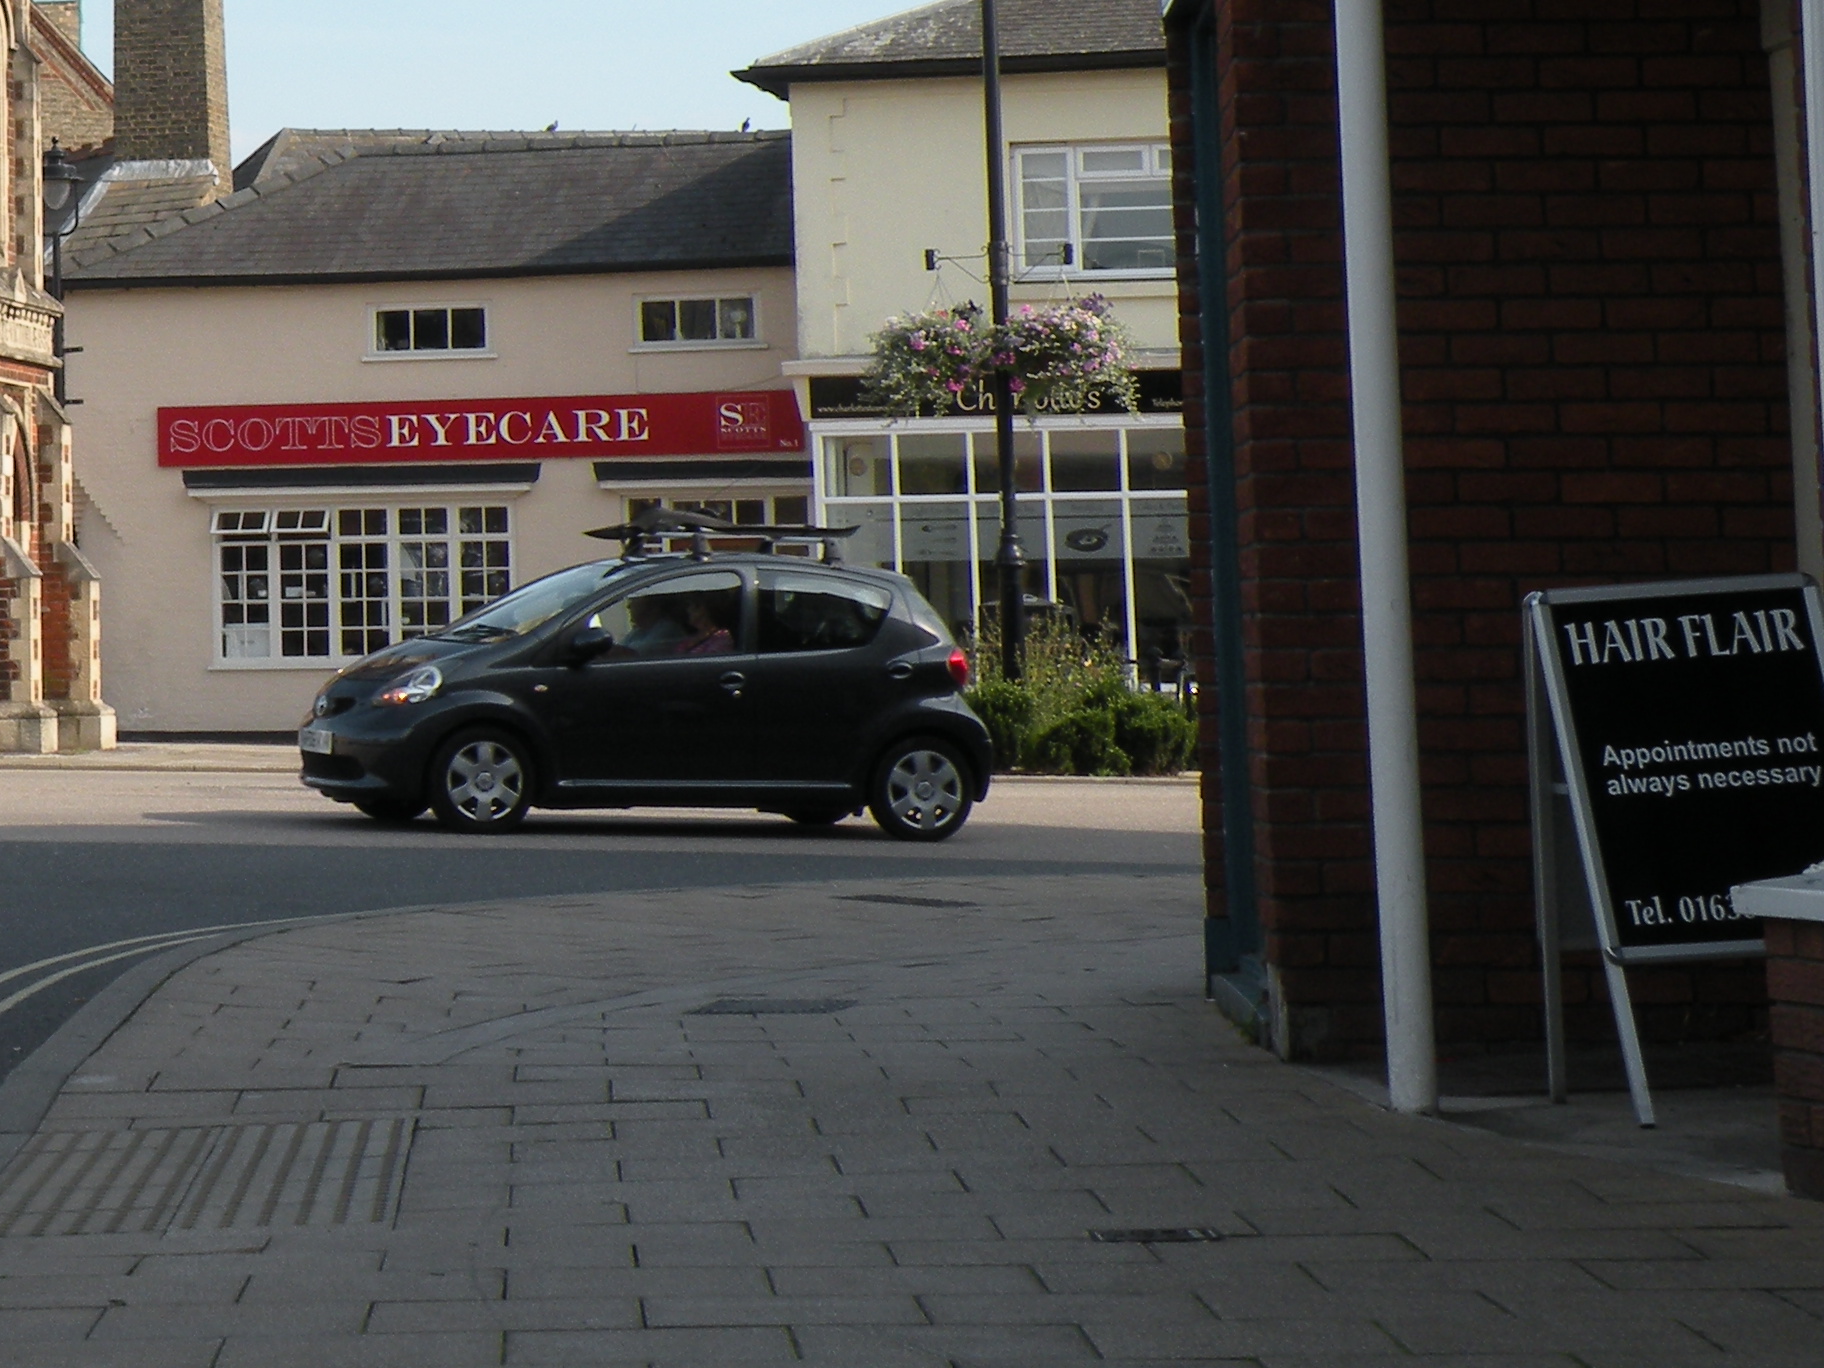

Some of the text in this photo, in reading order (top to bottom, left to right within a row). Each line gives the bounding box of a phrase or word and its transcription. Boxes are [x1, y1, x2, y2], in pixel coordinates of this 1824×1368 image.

[169, 407, 649, 454] SCOTTS EYECARE
[1563, 608, 1806, 666] HAIR FLAIR
[1603, 732, 1819, 770] Appointments not
[1607, 764, 1823, 797] always necessary
[1625, 893, 1756, 925] Tel. 016
